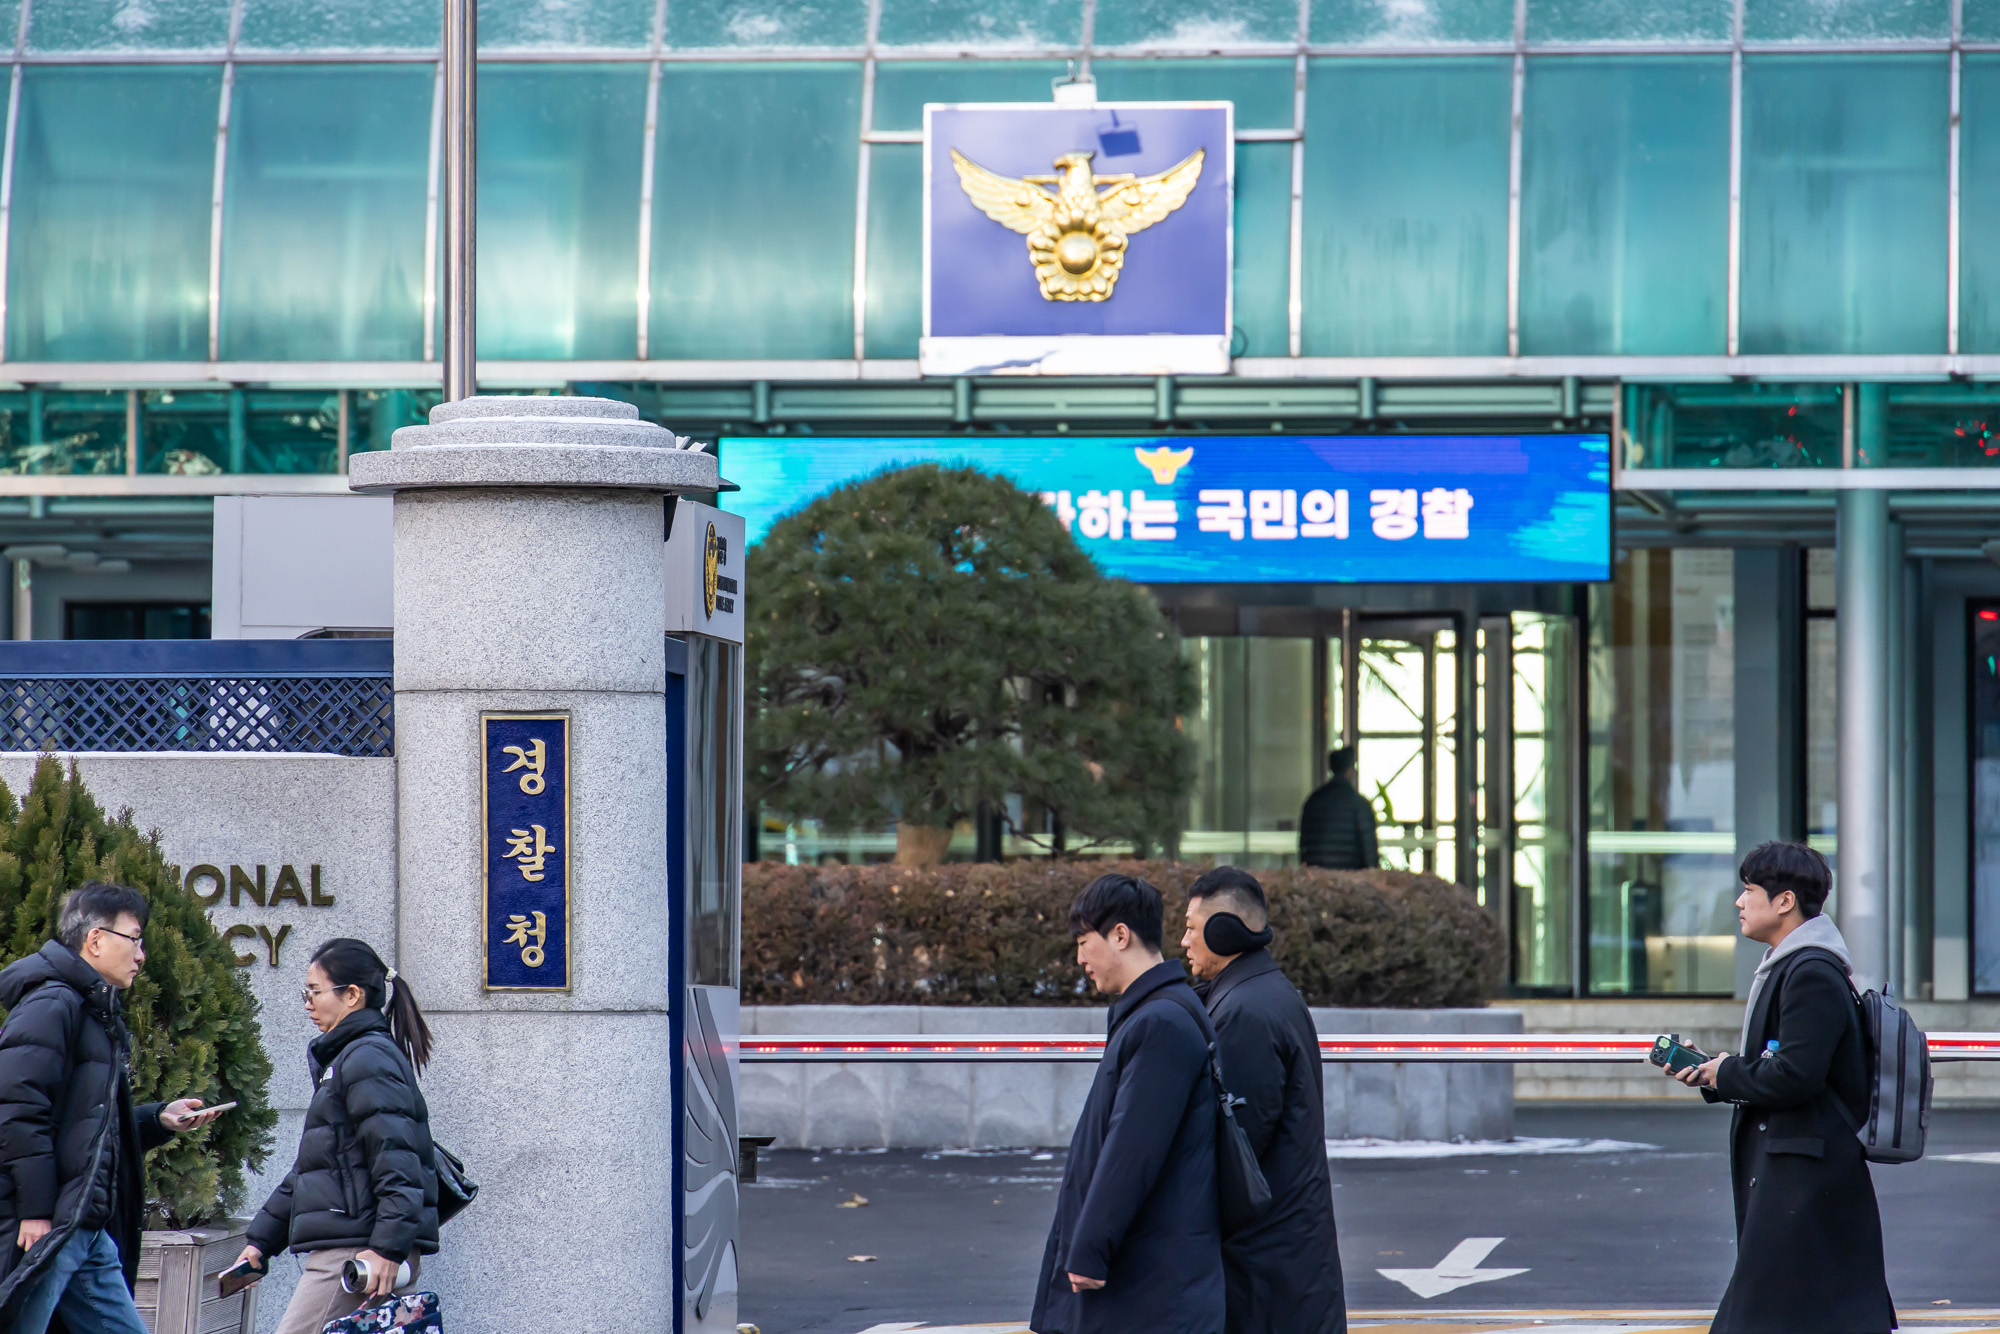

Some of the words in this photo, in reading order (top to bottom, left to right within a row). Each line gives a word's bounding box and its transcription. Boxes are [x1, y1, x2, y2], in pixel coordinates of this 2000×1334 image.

[1196, 488, 1350, 541] 국민의
[1369, 486, 1474, 541] 경찰
[501, 738, 557, 969] 경찰청
